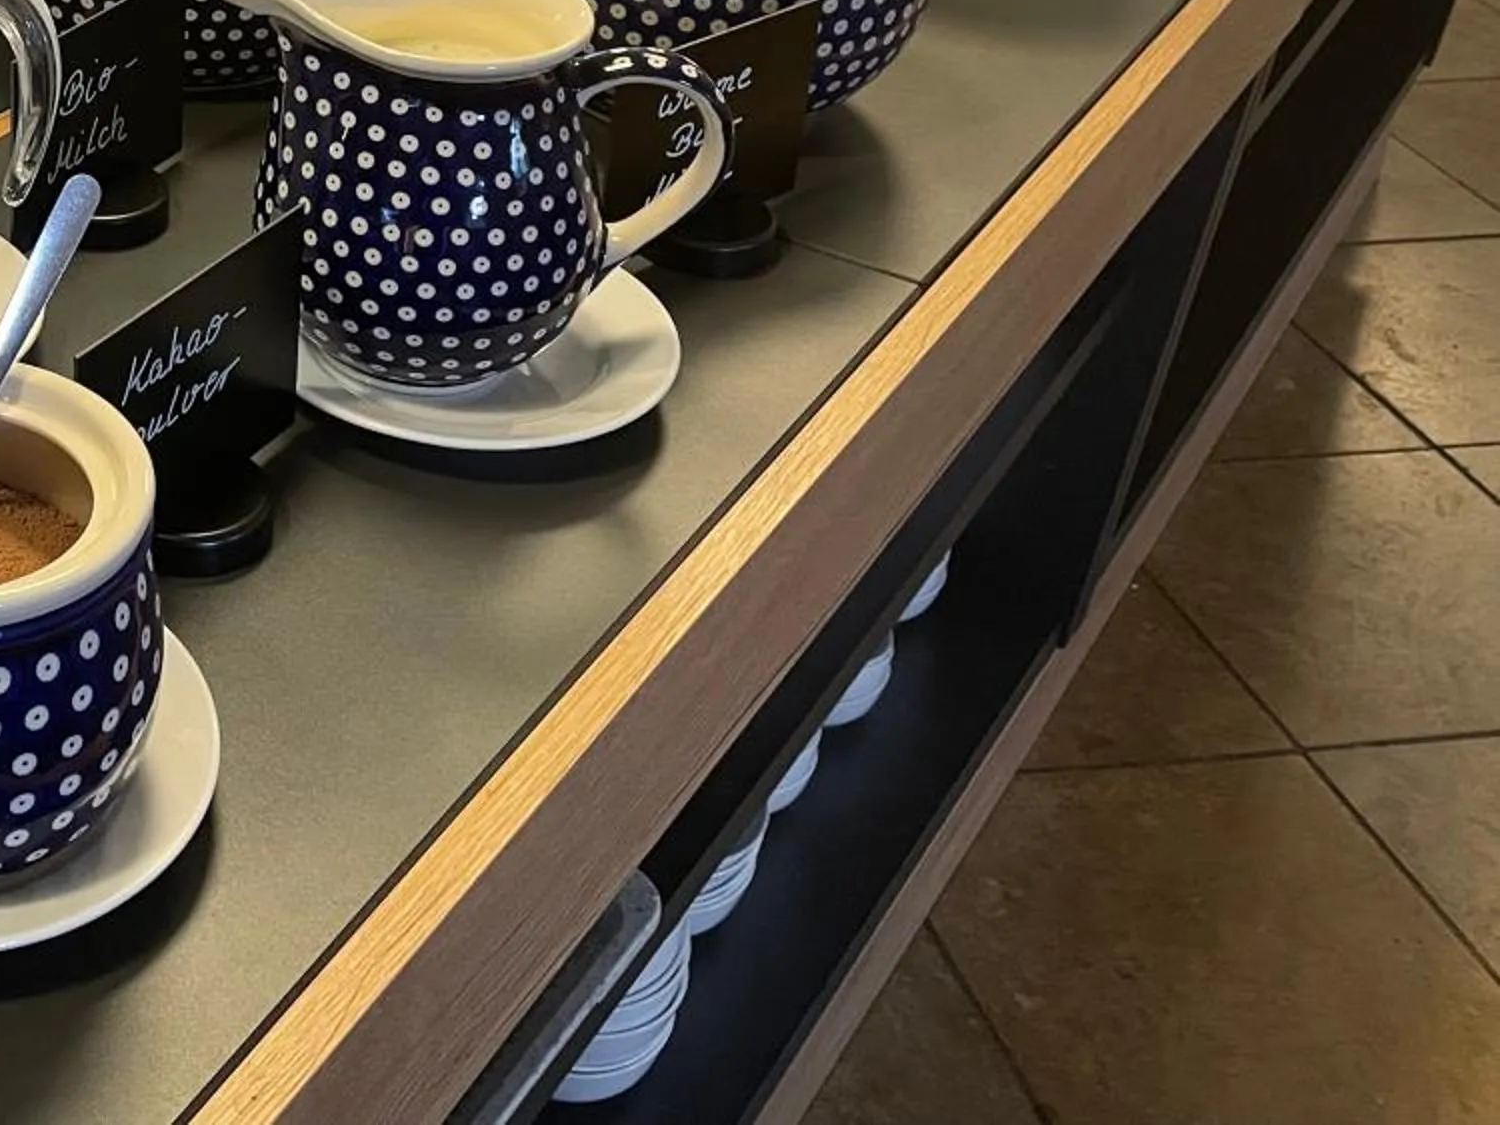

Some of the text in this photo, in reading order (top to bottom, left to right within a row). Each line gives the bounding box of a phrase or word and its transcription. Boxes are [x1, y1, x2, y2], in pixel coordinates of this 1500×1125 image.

[59, 58, 139, 117] Bio-
[47, 103, 128, 185] Milch
[121, 307, 247, 407] Kakao-
